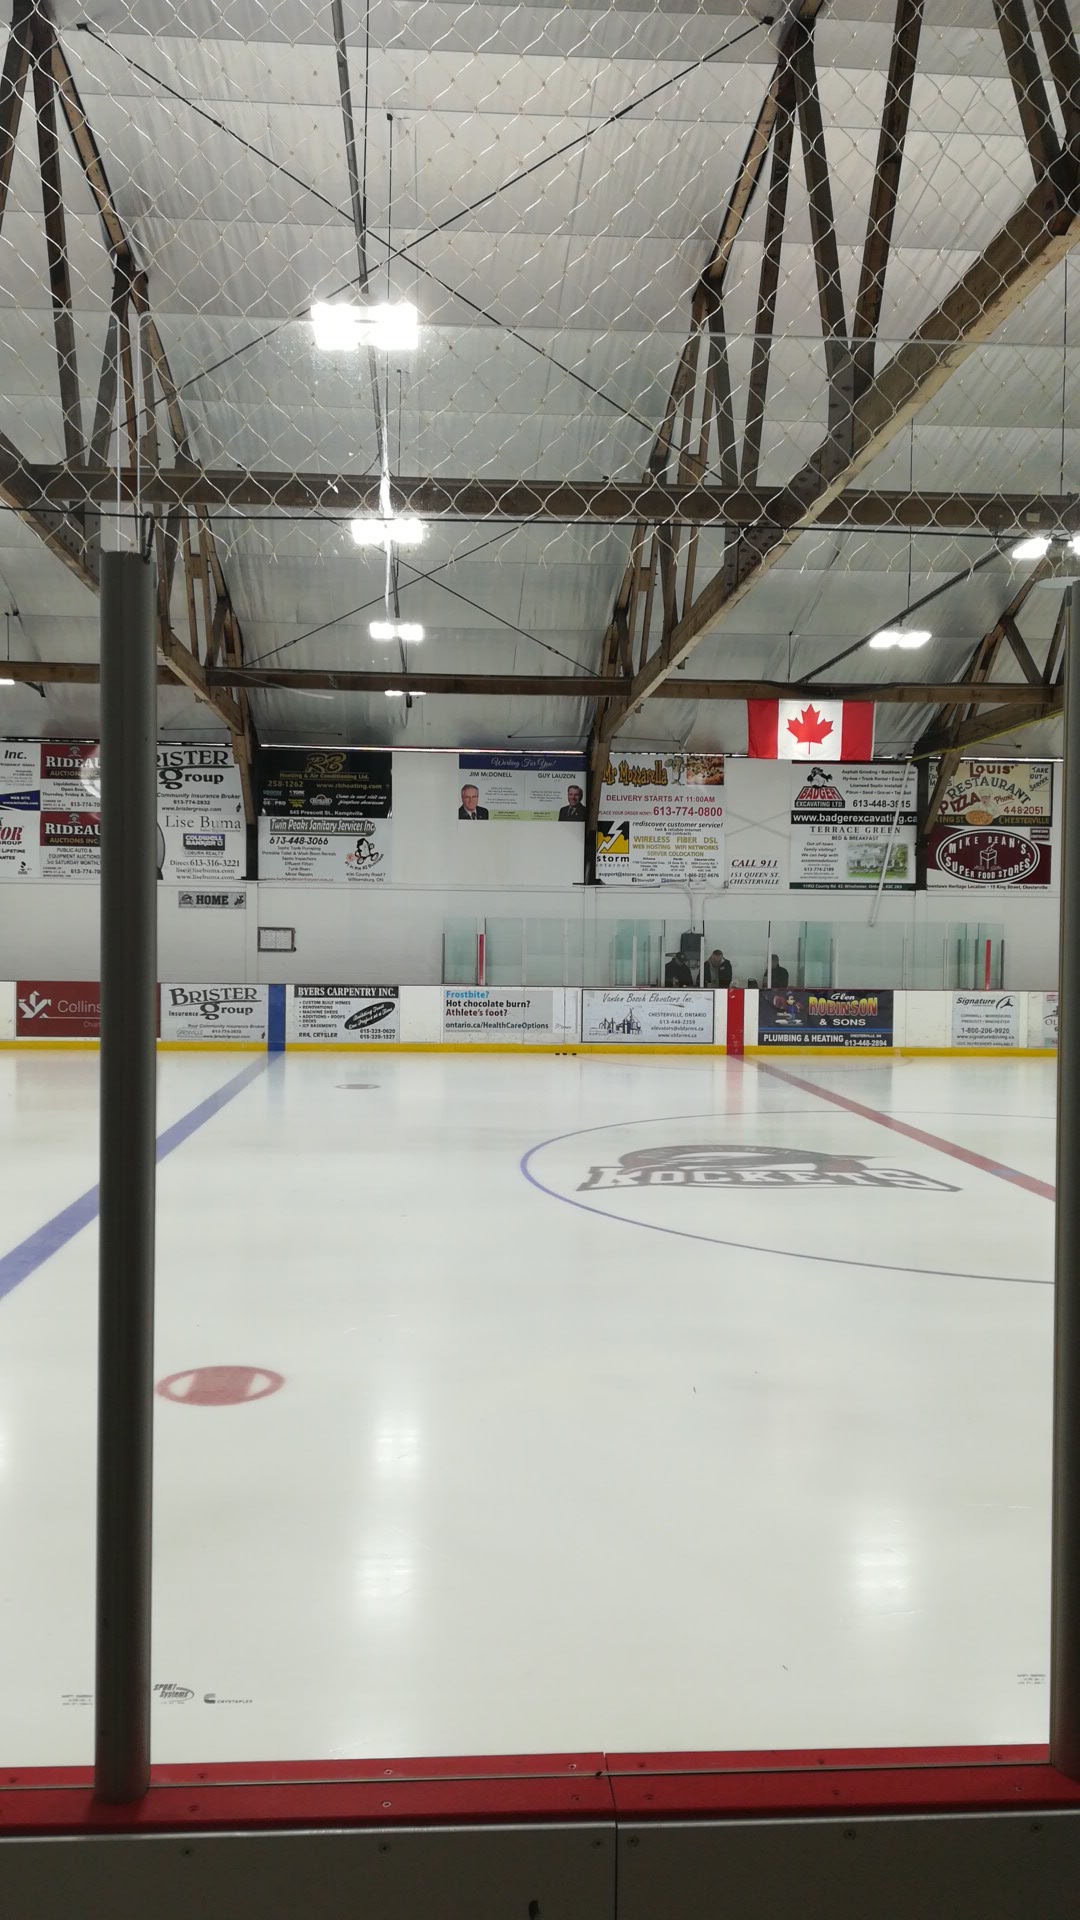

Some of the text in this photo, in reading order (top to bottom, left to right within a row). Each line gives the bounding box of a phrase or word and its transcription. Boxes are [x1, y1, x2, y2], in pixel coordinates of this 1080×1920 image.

[4, 750, 27, 760] Inc.
[156, 750, 229, 768] ISTER
[618, 759, 669, 787] Mozzarella
[158, 767, 224, 790] group
[267, 780, 304, 788] 258-1262
[799, 787, 840, 800] BADGER
[946, 776, 1032, 805] RESTAURANT
[606, 794, 642, 802] DELIVERY
[939, 791, 982, 815] PIZZA
[653, 806, 723, 817] 613-774-0800
[165, 815, 242, 829] Lise Buma
[271, 818, 288, 830] Twin
[309, 819, 338, 833] Sanitary
[337, 820, 363, 832] Services
[998, 816, 1050, 825] CHESTERVILLE
[45, 822, 101, 836] RIDEAU
[809, 826, 901, 834] TERRACE GREEN
[269, 836, 329, 845] 613-448-3066
[633, 835, 671, 843] WIRELESS
[948, 836, 1028, 855] MIKE DEAN'S
[189, 859, 240, 867] 613-316-3221
[596, 855, 630, 863] storm
[731, 859, 779, 868] CALL 911
[945, 856, 1031, 879] SUPER FOOD STORES
[195, 895, 229, 905] HOME
[168, 987, 258, 1006] BRISTER
[298, 987, 396, 997] BYERS CARPENTRY INC.
[445, 990, 490, 999] Frostbite?
[830, 992, 855, 1000] Glen
[626, 993, 647, 1003] Bosch
[648, 993, 680, 1003] Elevators
[956, 996, 996, 1005] Signature
[445, 999, 531, 1008] Hot chocolate burn?
[808, 996, 878, 1016] ROBINSON
[200, 1002, 254, 1020] group
[445, 1008, 508, 1017] Athlete's foot?
[445, 1021, 549, 1030] ontario.ca/HealthCareOptions
[819, 1018, 867, 1026] & SONS
[763, 1033, 844, 1043] PLUMBING & HEATING
[844, 1039, 888, 1047] 613-448-2894
[577, 1165, 963, 1192] ROCKETS
[153, 1683, 178, 1691] SPORT
[159, 1690, 190, 1699] Systems
